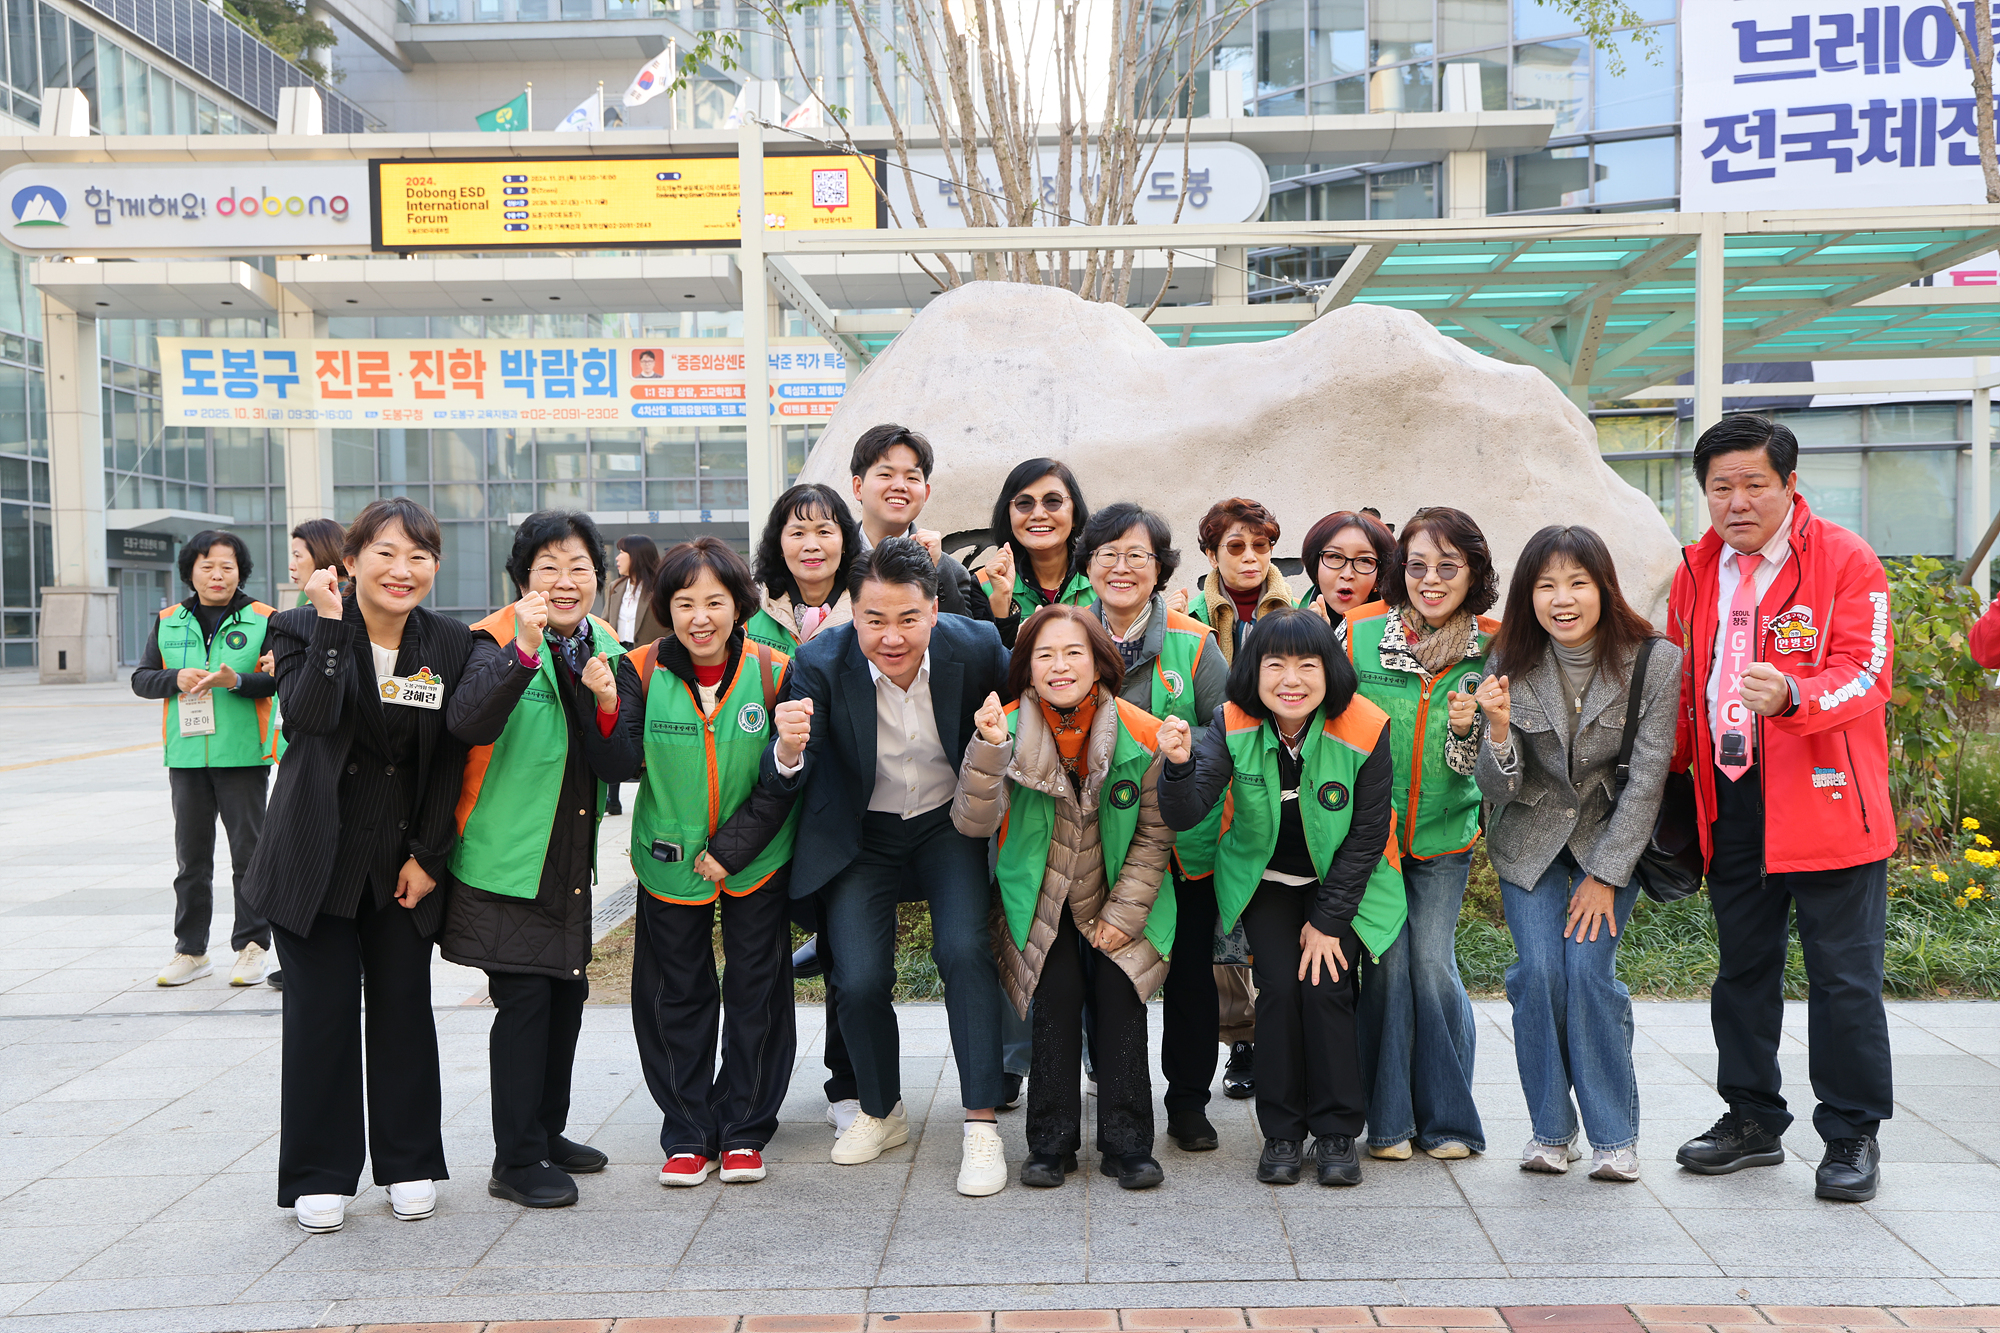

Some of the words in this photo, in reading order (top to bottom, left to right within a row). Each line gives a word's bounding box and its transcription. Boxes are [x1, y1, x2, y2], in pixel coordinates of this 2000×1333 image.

[1732, 2, 2000, 84] 브레이
[405, 177, 437, 186] 2024.
[406, 188, 457, 200] Dobong
[460, 187, 485, 198] ESD
[1147, 168, 1213, 209] 도봉
[84, 185, 208, 226] 함께해요!
[216, 186, 350, 222] dobong
[406, 200, 489, 211] International
[407, 213, 449, 224] Forum
[768, 353, 792, 370] 낙준
[796, 353, 820, 370] 작가
[181, 348, 300, 399] 도봉구
[315, 348, 488, 400] 진로·진학
[500, 347, 620, 399] 박람회
[382, 409, 423, 421] 도봉구청
[450, 410, 475, 419] 도봉구
[477, 410, 518, 420] 교육지원과
[530, 408, 619, 420] 02-2091-2302
[783, 404, 808, 414] 이벤트
[810, 404, 838, 414] 프로그
[1733, 618, 1748, 626] 창동
[1778, 637, 1814, 649] 안병건
[402, 689, 437, 704] 강혜란
